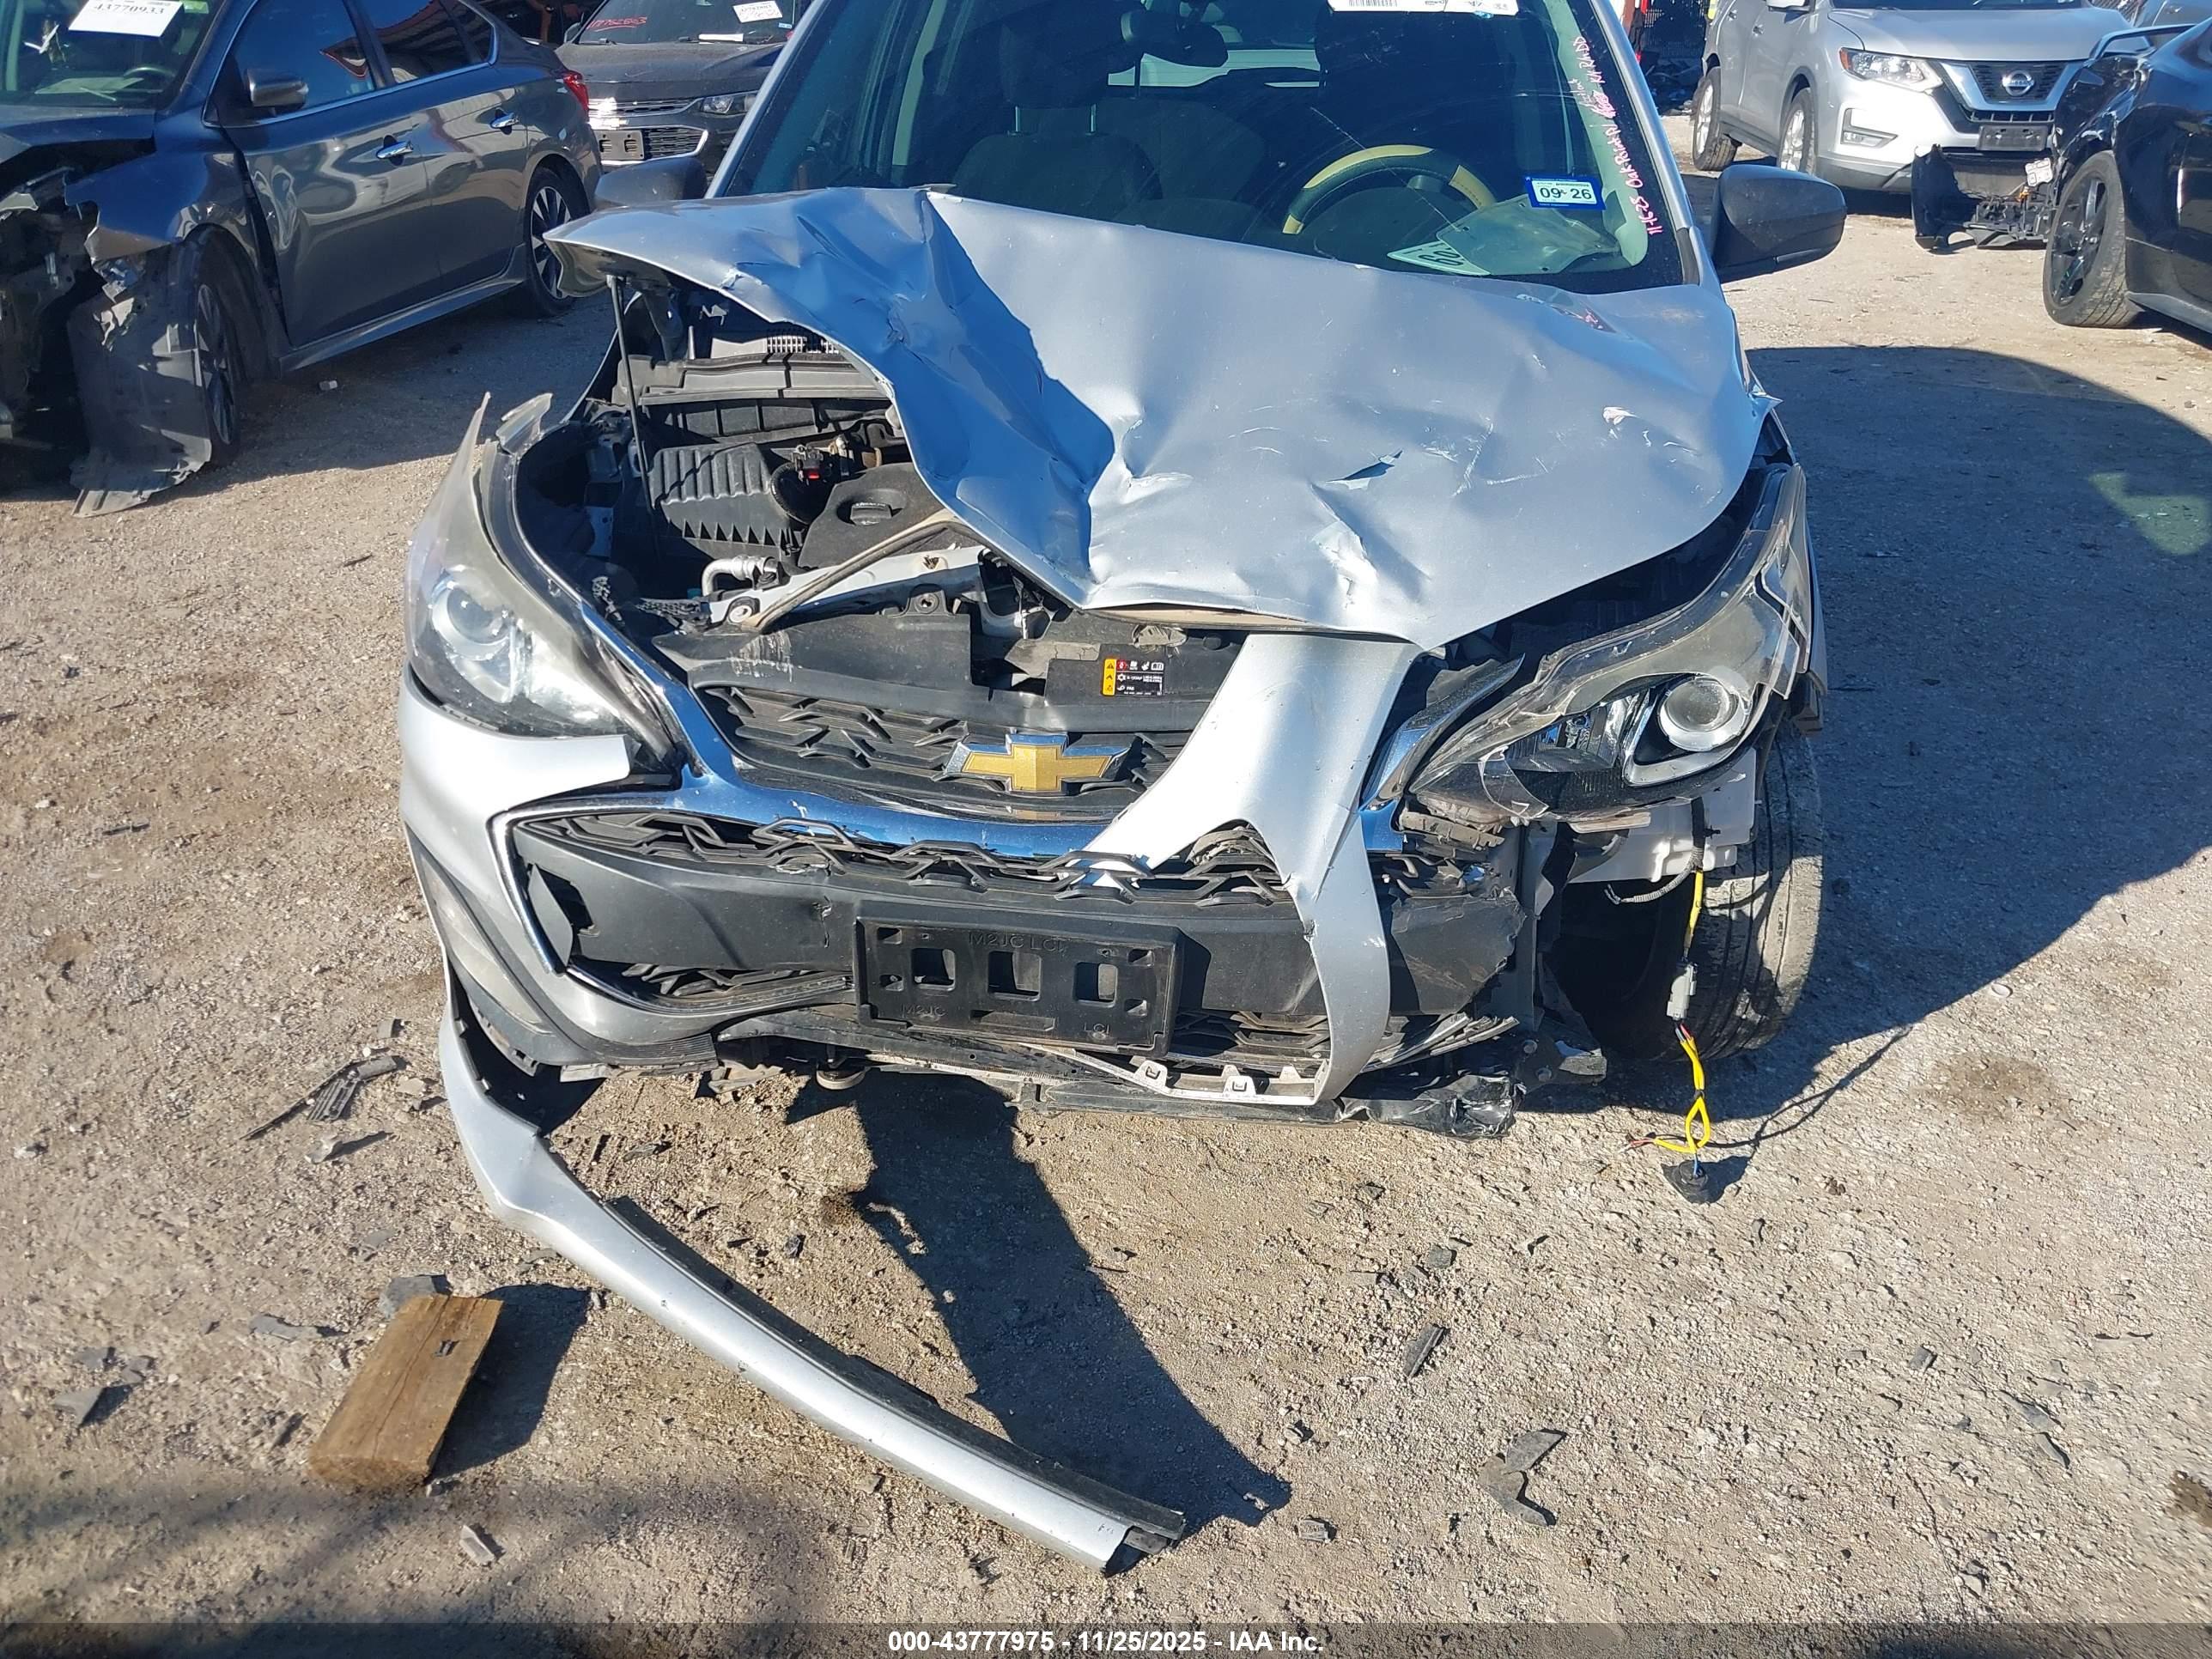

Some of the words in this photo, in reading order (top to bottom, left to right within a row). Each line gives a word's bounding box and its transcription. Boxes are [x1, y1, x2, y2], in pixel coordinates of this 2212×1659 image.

[94, 3, 165, 15] 43770933
[1540, 187, 1562, 198] 09
[1571, 188, 1592, 200] 26
[969, 932, 1024, 948] M2JC
